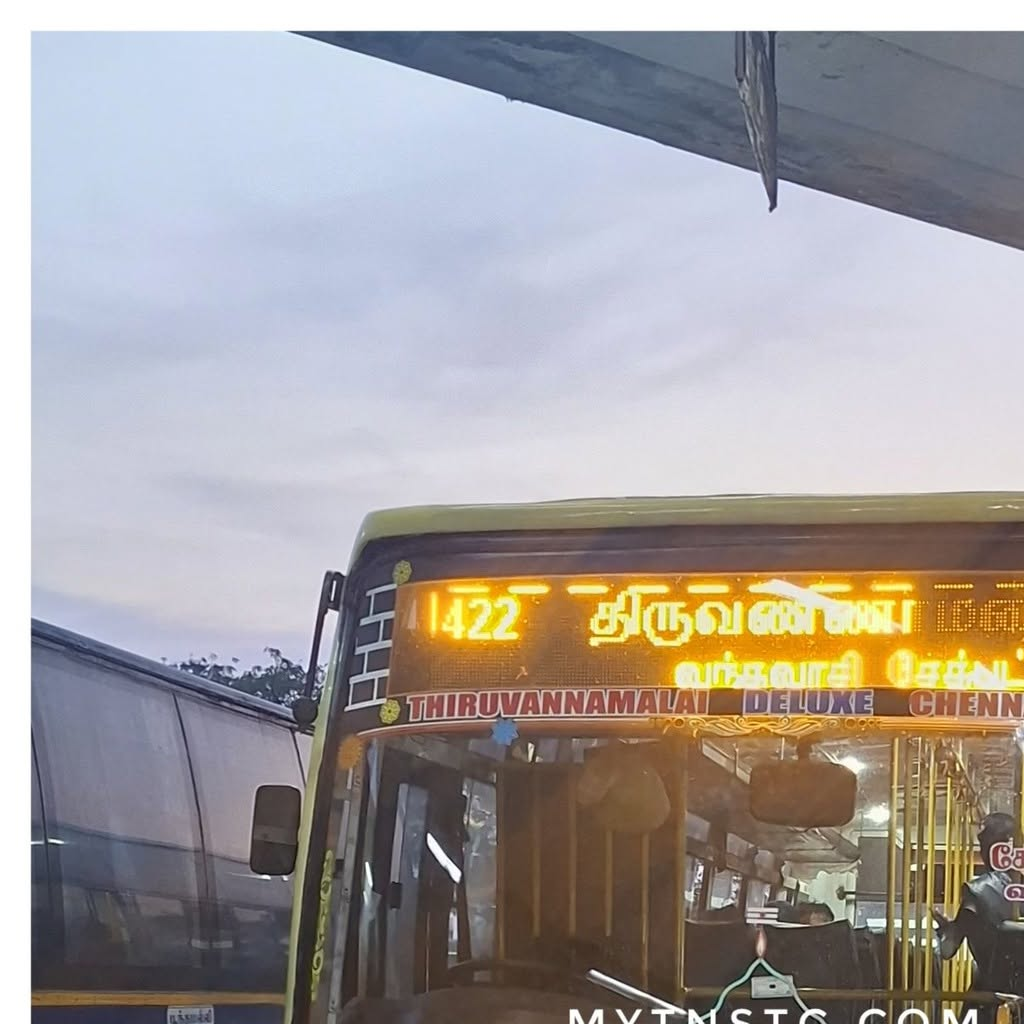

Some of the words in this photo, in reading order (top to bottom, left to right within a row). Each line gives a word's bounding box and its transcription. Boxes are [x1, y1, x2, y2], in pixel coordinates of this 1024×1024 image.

[441, 596, 521, 641] 422
[406, 688, 712, 722] THIRUVANNAMALAI
[742, 689, 874, 717] DELUXE
